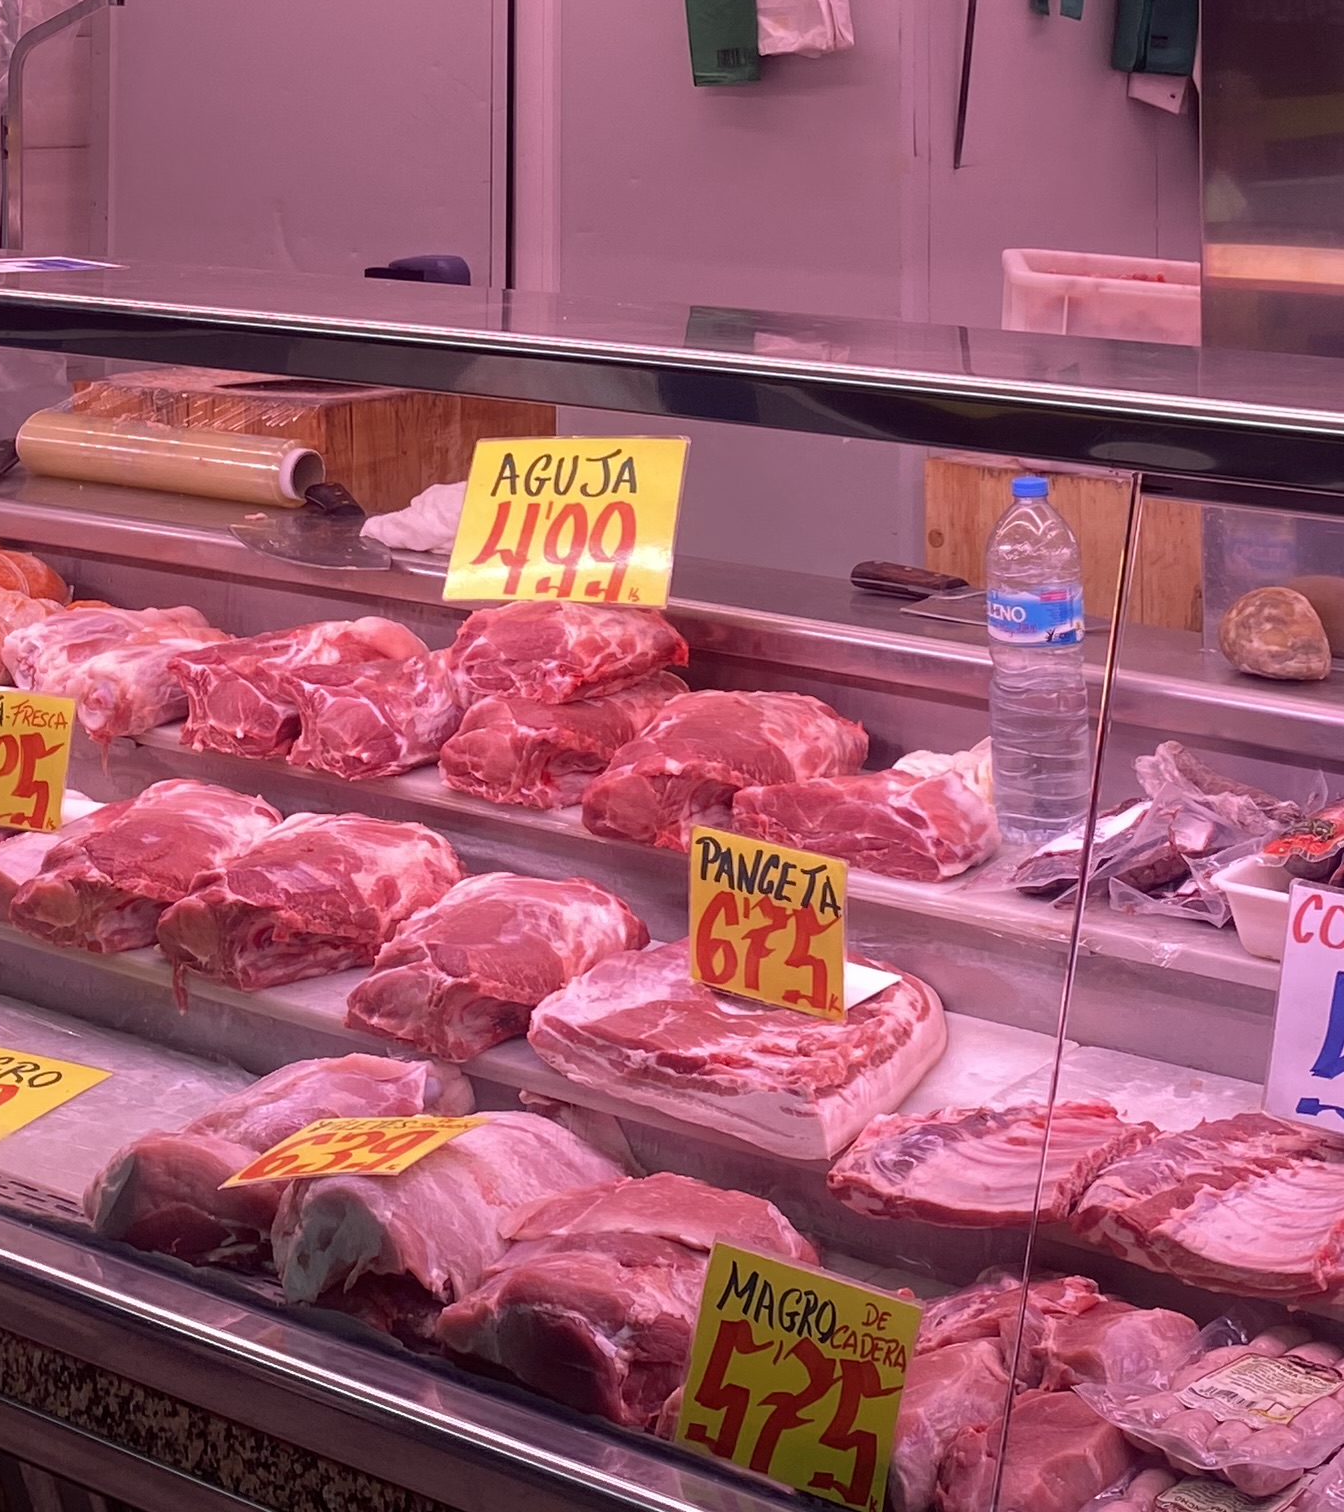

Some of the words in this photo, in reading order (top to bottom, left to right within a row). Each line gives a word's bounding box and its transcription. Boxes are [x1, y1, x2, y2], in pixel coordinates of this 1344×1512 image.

[490, 449, 637, 497] AGUJA
[470, 500, 637, 602] 4'99
[695, 890, 842, 1010] 6'75
[716, 1260, 837, 1344] MAGRO
[862, 1302, 893, 1331] DE
[830, 1324, 907, 1373] CADERA
[684, 1319, 905, 1508] 5'75
